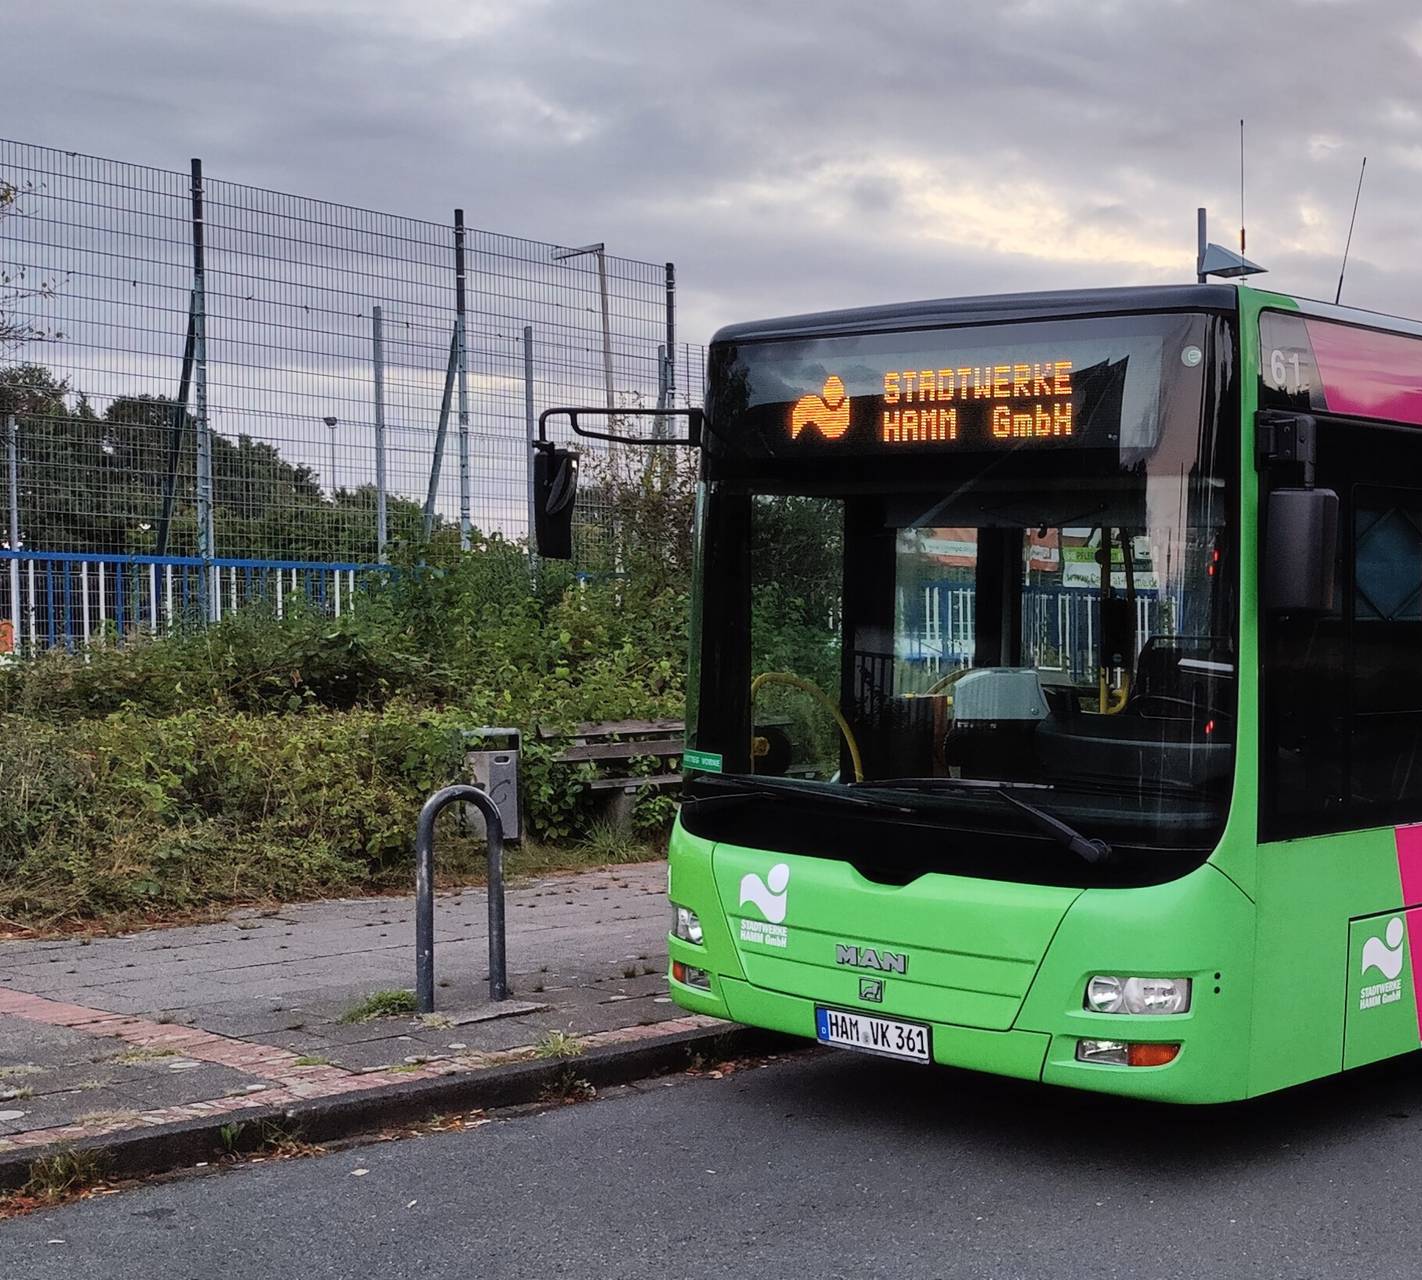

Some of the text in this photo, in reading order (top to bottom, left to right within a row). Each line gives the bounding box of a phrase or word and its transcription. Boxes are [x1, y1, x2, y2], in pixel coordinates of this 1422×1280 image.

[884, 361, 1073, 403] STADTWERKE
[1271, 350, 1300, 387] 61
[884, 403, 1073, 442] HAMM GmbH
[740, 919, 788, 937] STADTWERKE
[740, 930, 788, 948] HAMM GmbH
[836, 944, 907, 975] MAN
[1360, 979, 1402, 999] STADTWERKE
[1360, 989, 1402, 1010] HAMM GmbH
[828, 1013, 860, 1042] HAM
[869, 1021, 891, 1048] VK
[894, 1025, 927, 1055] 361
